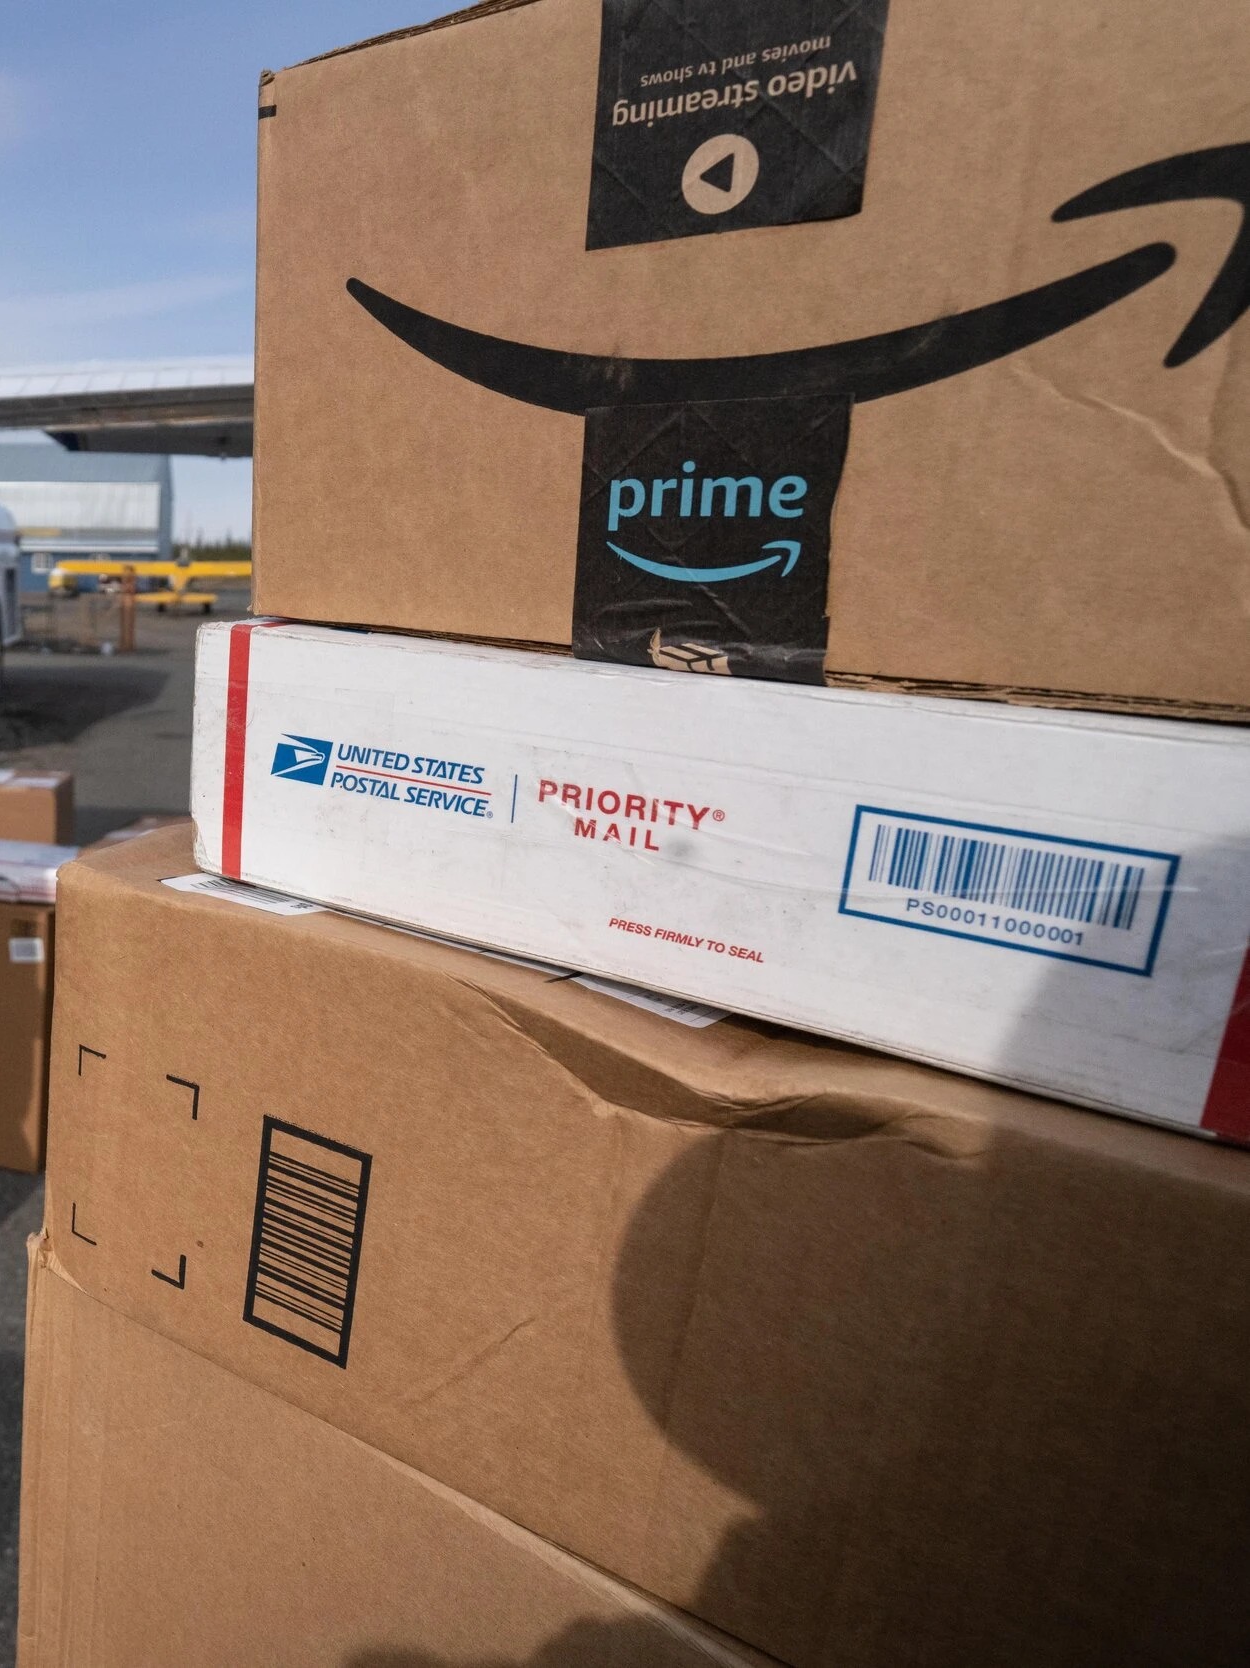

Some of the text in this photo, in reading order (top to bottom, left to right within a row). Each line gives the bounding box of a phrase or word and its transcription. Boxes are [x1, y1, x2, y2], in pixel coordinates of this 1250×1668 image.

[640, 36, 831, 87] movies and tv shows
[612, 60, 857, 127] video streaming
[608, 460, 808, 532] prime
[330, 771, 400, 800] POSTAL
[337, 743, 485, 784] UNITED STATES
[574, 817, 659, 851] MAIL
[608, 917, 764, 963] PRESS FIRMLY TO SEAL
[906, 898, 1084, 946] PS00011000001
